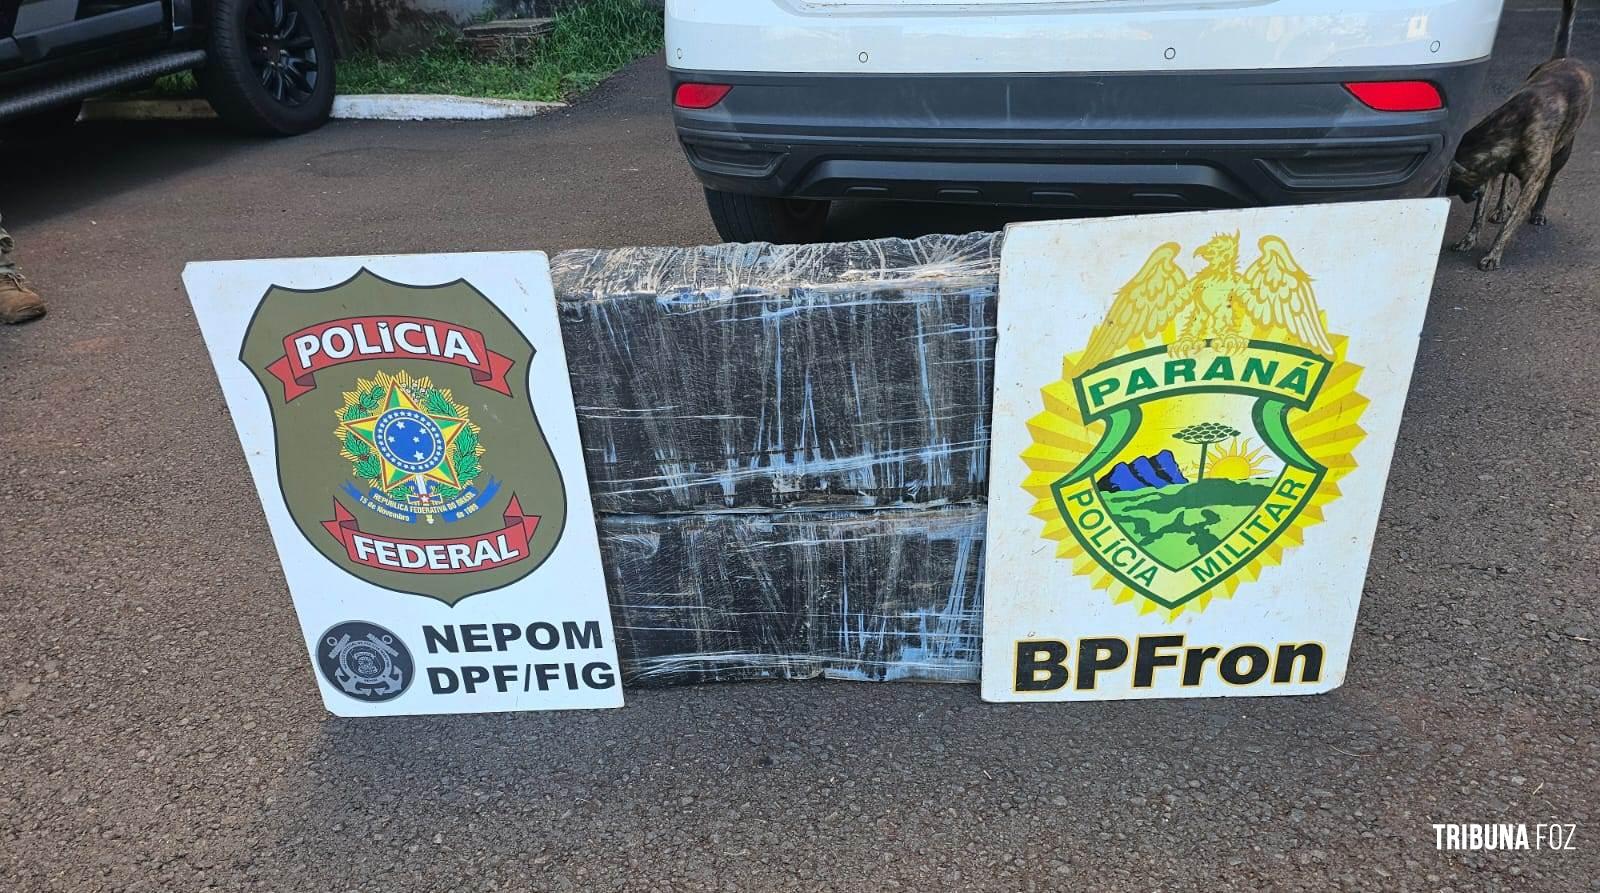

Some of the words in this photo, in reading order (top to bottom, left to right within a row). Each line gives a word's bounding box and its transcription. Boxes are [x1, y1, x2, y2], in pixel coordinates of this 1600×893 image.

[1088, 356, 1314, 408] PARANÁ
[376, 505, 410, 522] Novembro
[352, 533, 521, 570] FEDERAL
[1067, 488, 1158, 588] POLÍCIA
[1191, 478, 1306, 584] MILITAR
[422, 620, 604, 654] NEPOM
[426, 661, 616, 695] DPF/FIG
[1013, 634, 1326, 694] BPFron
